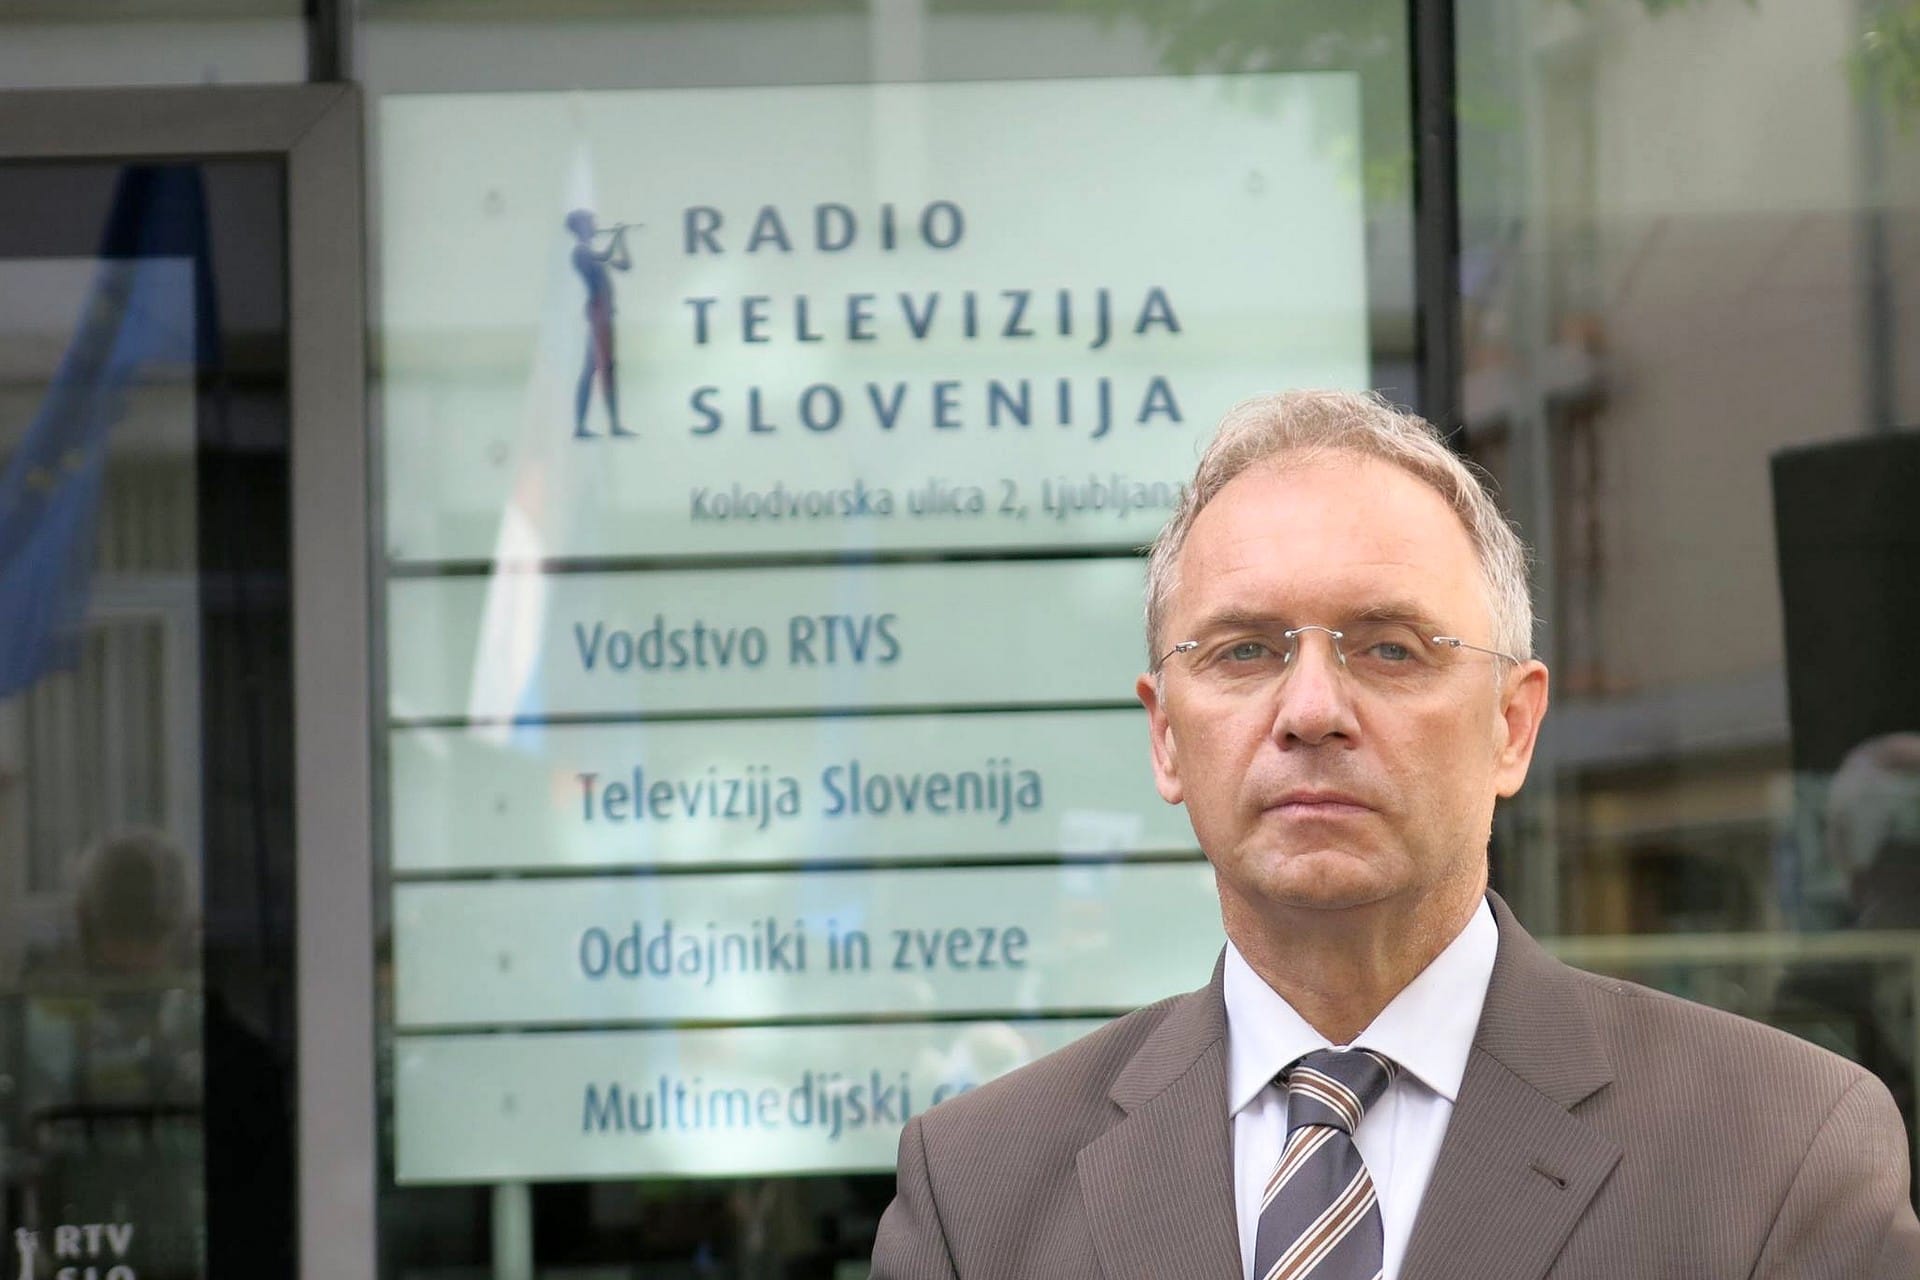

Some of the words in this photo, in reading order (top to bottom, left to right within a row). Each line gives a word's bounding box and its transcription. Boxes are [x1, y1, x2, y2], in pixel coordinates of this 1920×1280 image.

[683, 200, 967, 255] RADIO
[683, 286, 1183, 349] TELEVIZIJA
[690, 375, 1184, 439] SLOVENIJA
[690, 478, 894, 521] Kolodvorska
[908, 476, 986, 516] ulica
[998, 478, 1028, 520] 2,
[574, 614, 768, 671] Vodstvo
[788, 613, 901, 666] RTVS
[577, 764, 800, 829] Televizija
[822, 758, 1043, 824] Slovenija
[580, 919, 807, 983] Oddajniki
[827, 920, 870, 970] in
[892, 925, 1029, 970] zveze
[582, 1069, 910, 1138] Multimedijski
[55, 1222, 134, 1258] RTV
